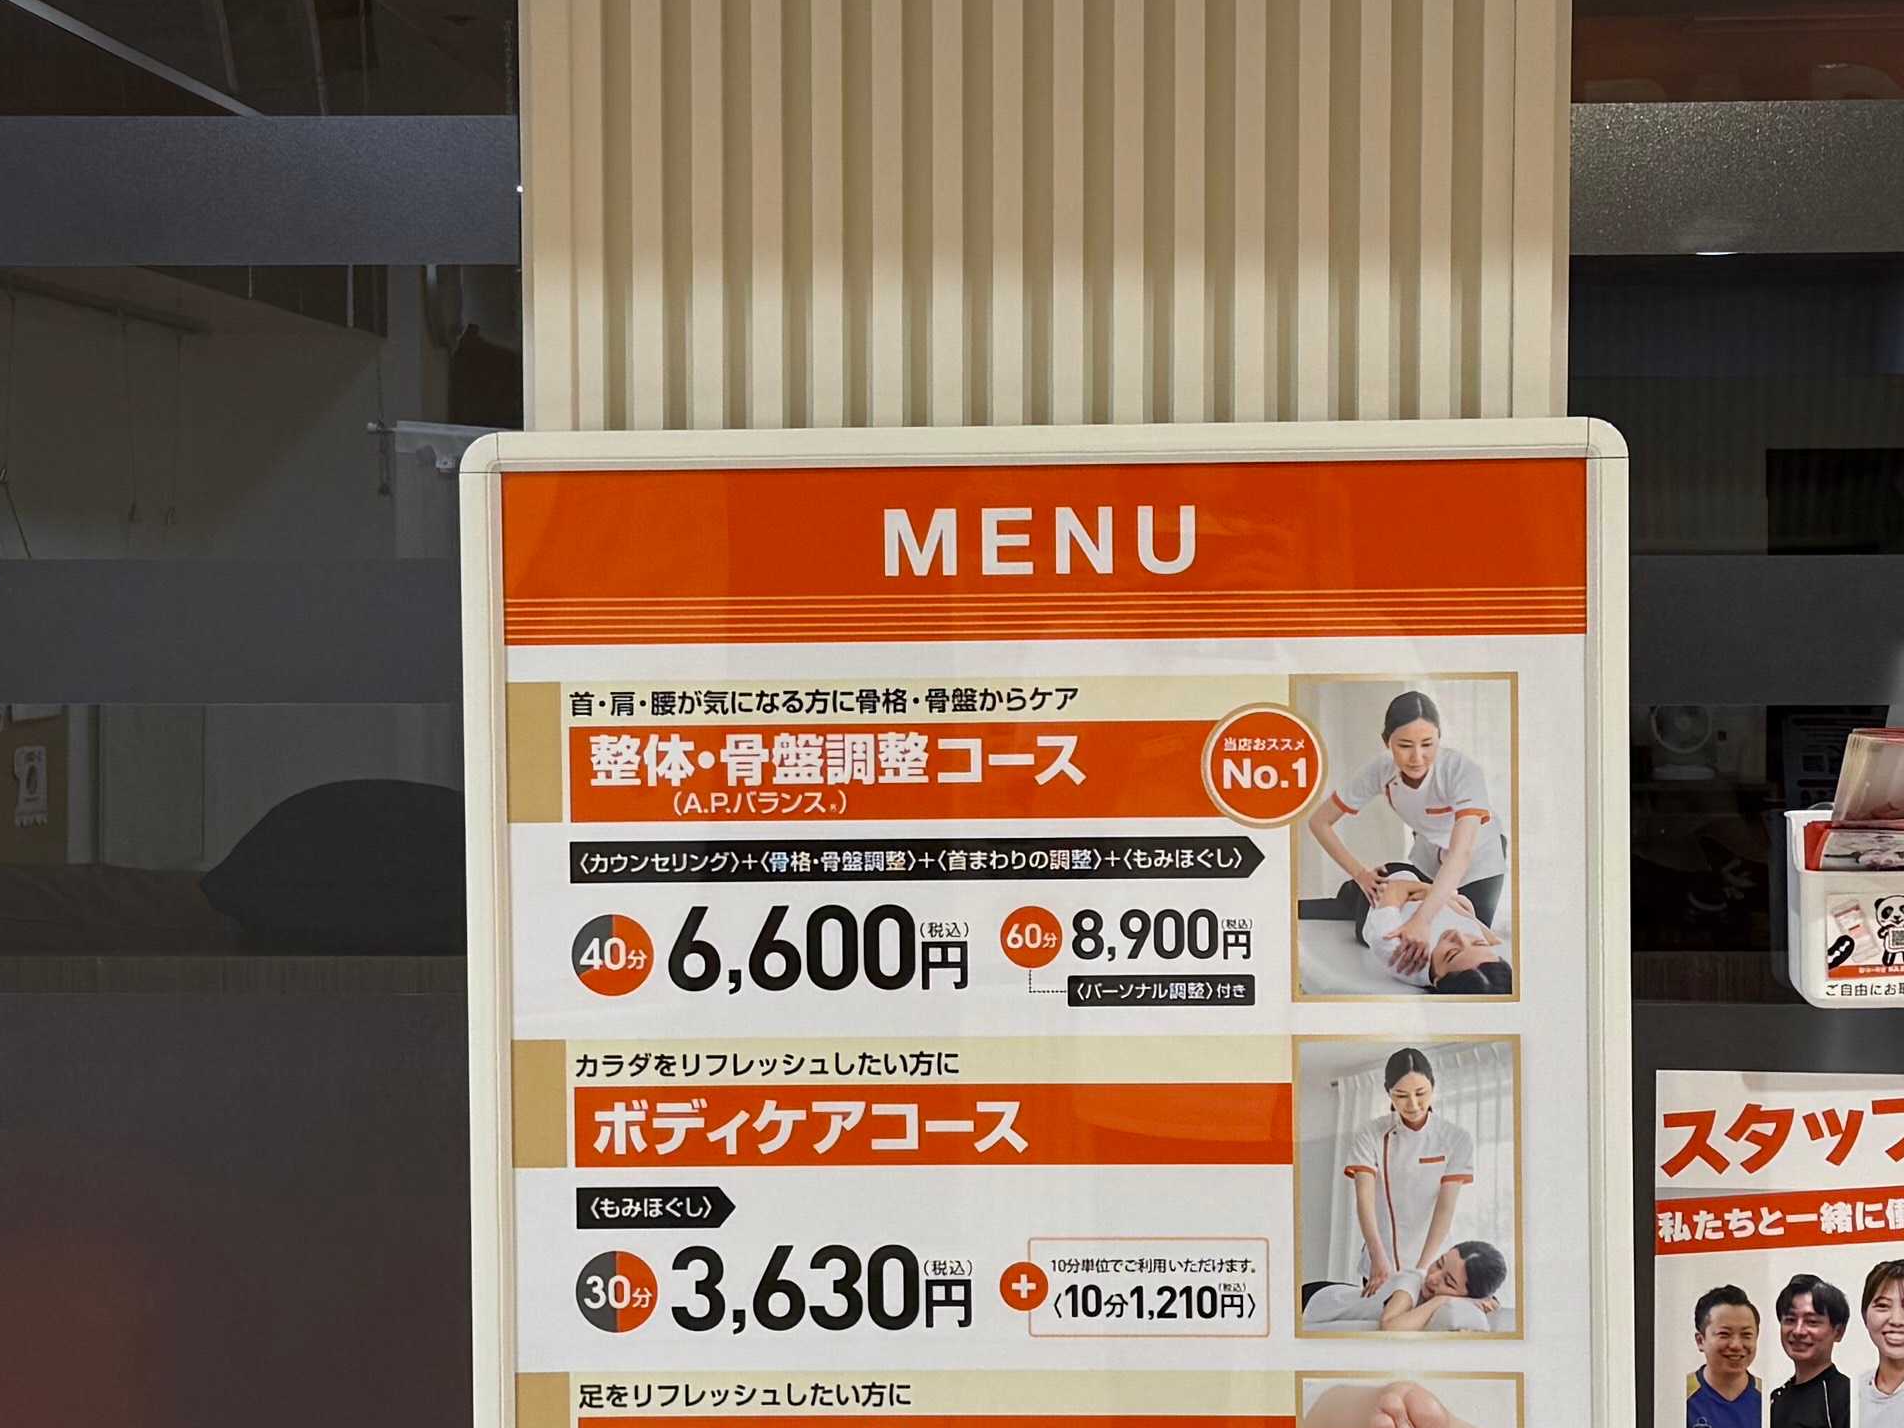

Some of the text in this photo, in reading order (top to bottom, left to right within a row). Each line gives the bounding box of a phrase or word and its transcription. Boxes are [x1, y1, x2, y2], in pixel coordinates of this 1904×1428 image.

[884, 506, 1195, 576] MENU
[570, 688, 1078, 716] 首・肩・腰が気になる方に骨格・骨盤からケア
[590, 732, 1086, 786] 整体・骨盤調整コース
[1223, 736, 1306, 753] 当店おススメ
[1223, 758, 1306, 789] No.1
[580, 903, 969, 995] 40分 6,600円
[1006, 908, 1253, 963] 60分 8,900円
[576, 1051, 959, 1077] カラダをリフレッシュしたい方に
[594, 1099, 1028, 1154] ボディケアコース
[1052, 1259, 1255, 1273] 10分単位でご利用いただけます。
[583, 1244, 973, 1336] 30分 3,630円
[579, 1382, 911, 1408] 足をリフレッシュしたい方に
